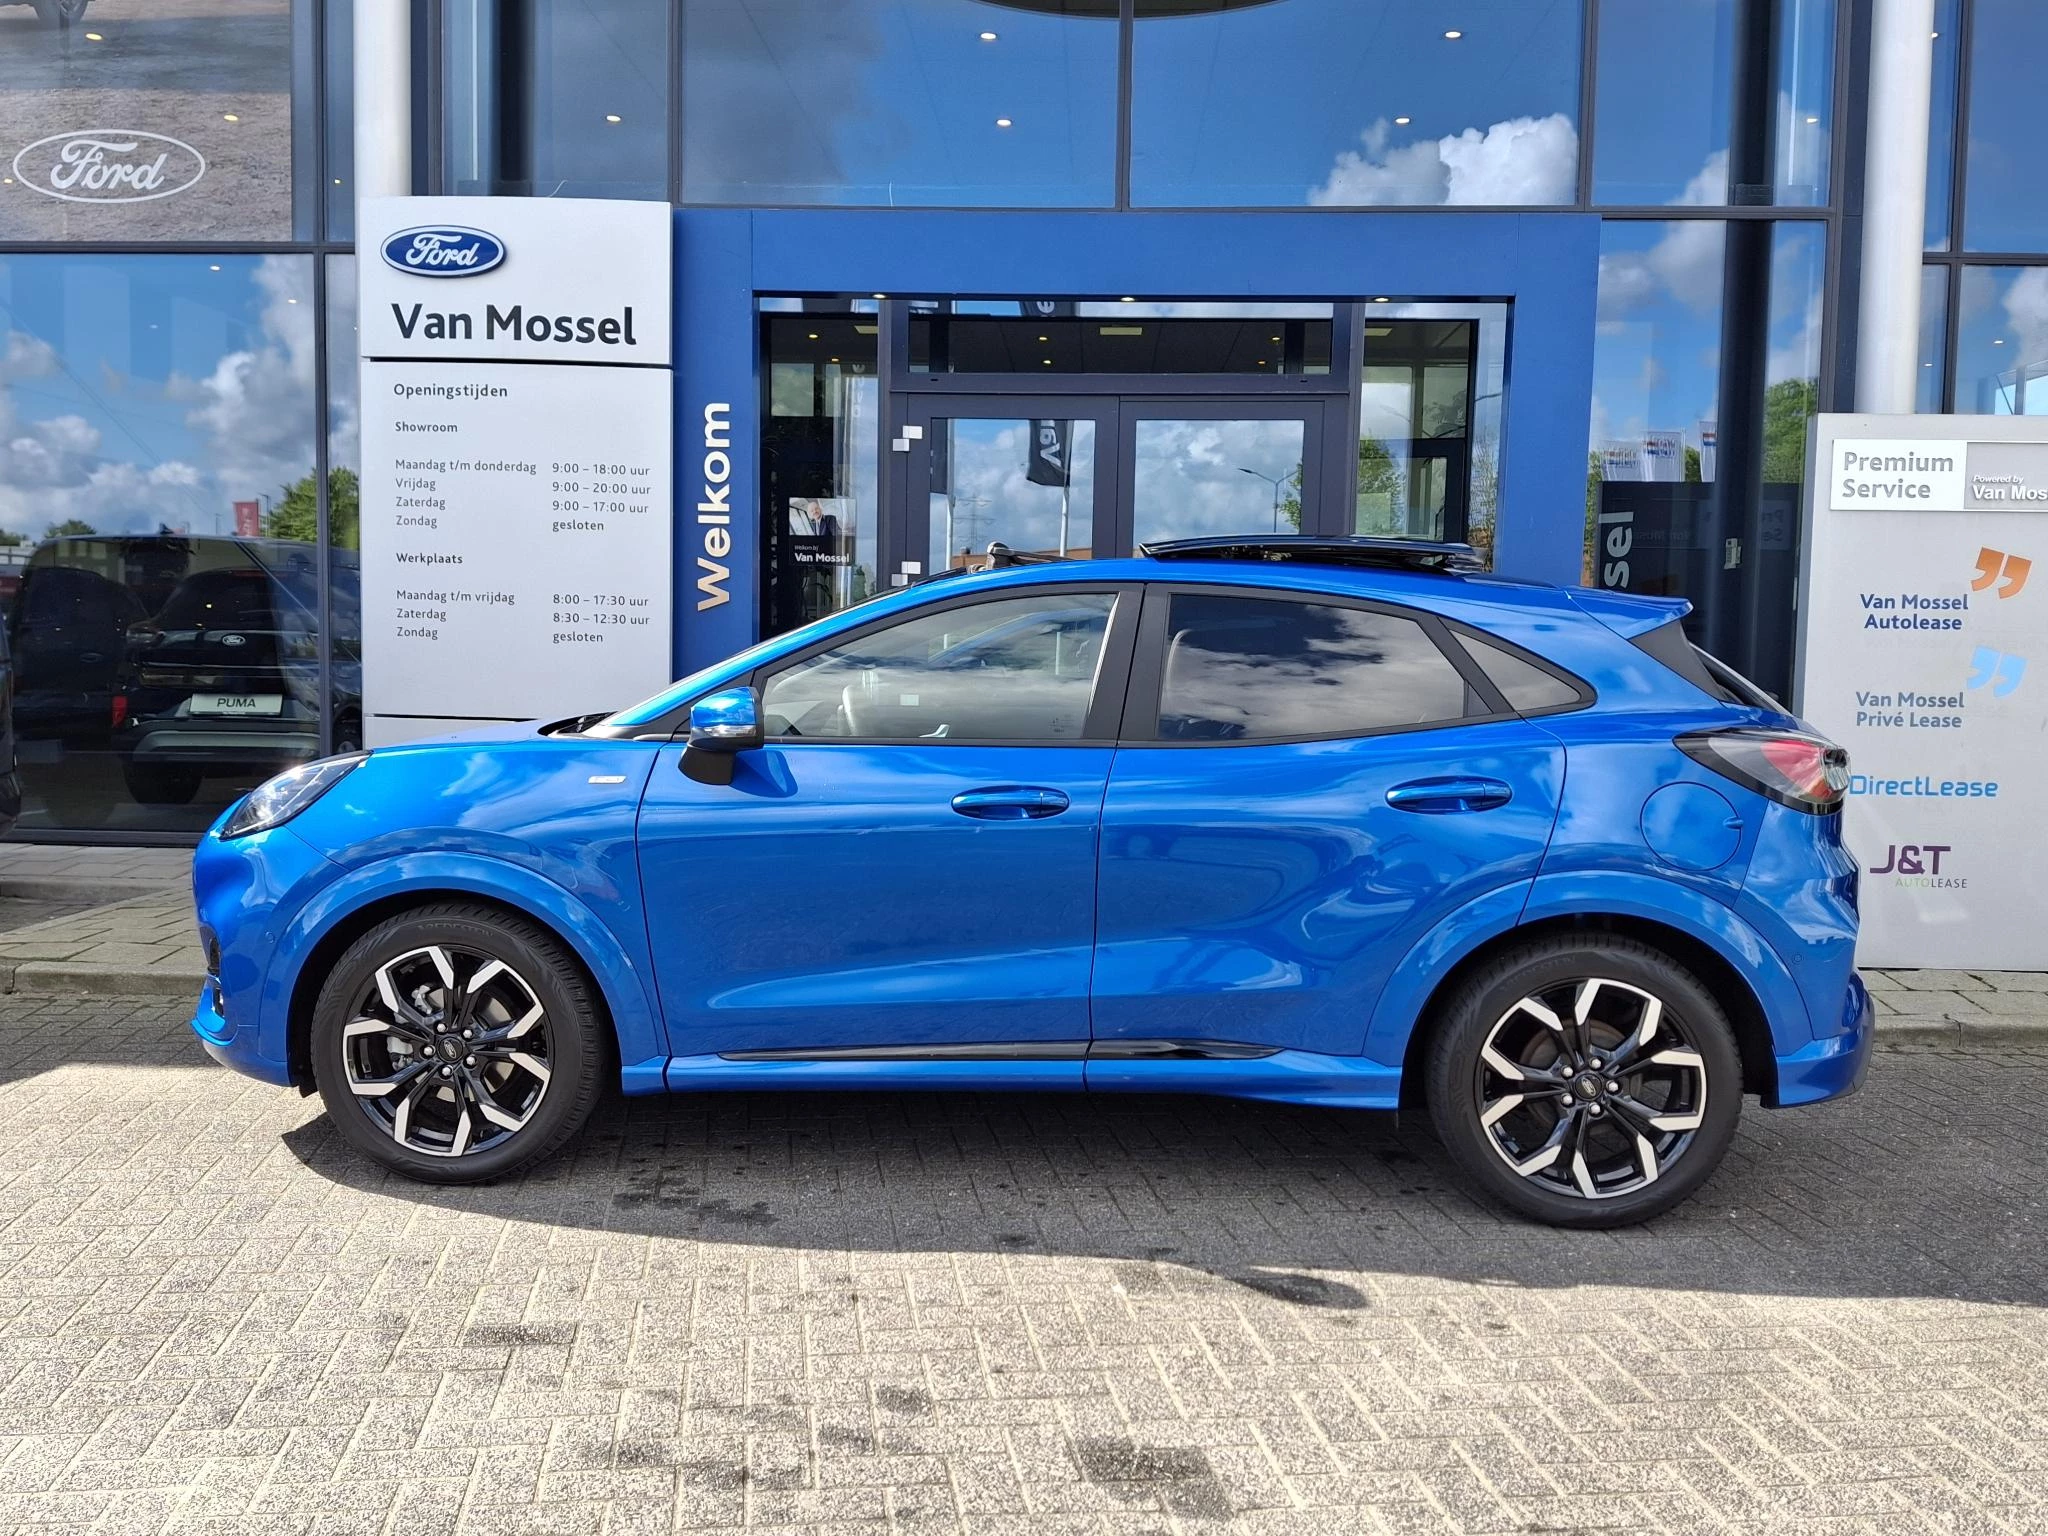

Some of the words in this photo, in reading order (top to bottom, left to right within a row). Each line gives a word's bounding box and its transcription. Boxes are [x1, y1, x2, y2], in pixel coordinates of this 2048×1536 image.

[50, 139, 168, 190] Ford
[404, 232, 481, 267] Ford
[390, 302, 473, 340] Van
[486, 304, 637, 346] Mossel
[393, 383, 508, 401] Openingstijden
[395, 420, 458, 433] Showroom
[395, 458, 447, 474] Maandag
[449, 459, 471, 472] t/m
[473, 459, 537, 476] donderdag
[552, 462, 579, 474] 9:00
[592, 463, 627, 475] 18:00
[630, 467, 651, 476] uur
[1843, 450, 1954, 473] Premium
[395, 477, 437, 492] Vrijdag
[552, 481, 580, 493] 9:00
[592, 482, 628, 495] 20:00
[631, 486, 651, 495] uur
[1841, 477, 1931, 499] Service
[1972, 474, 2011, 484] Powered
[2012, 474, 2024, 484] by
[1972, 484, 2006, 500] Van
[395, 495, 446, 511] Zaterdag
[552, 499, 580, 512] 9:00
[593, 501, 626, 513] 17:00
[629, 505, 649, 514] uur
[697, 402, 733, 613] Welkom
[395, 514, 438, 530] Zondag
[552, 519, 604, 533] gesloten
[395, 552, 463, 567] Werkplaats
[794, 552, 813, 562] Van
[815, 552, 850, 562] Mossel
[396, 589, 447, 604] Maandag
[450, 590, 472, 602] t/m
[474, 591, 515, 606] vrijdag
[552, 593, 580, 605] 8:00
[593, 594, 626, 606] 17:30
[629, 598, 649, 607] uur
[1859, 593, 1896, 610] Van
[1901, 593, 1969, 611] Mossel
[396, 607, 447, 623] Zaterdag
[552, 612, 580, 624] 8:30
[593, 613, 627, 625] 12:30
[630, 616, 650, 625] uur
[1863, 613, 1963, 631] Autolease
[396, 626, 439, 641] Zondag
[552, 631, 604, 645] gesloten
[217, 698, 256, 708] PUMA
[1855, 691, 1892, 708] Van
[1897, 691, 1965, 709] Mossel
[1856, 710, 1905, 728] Privé
[1909, 711, 1963, 729] Lease
[1849, 774, 1999, 798] DirectLease
[1869, 844, 1952, 876] J&T
[1894, 878, 1969, 890] AUTOLEASE
